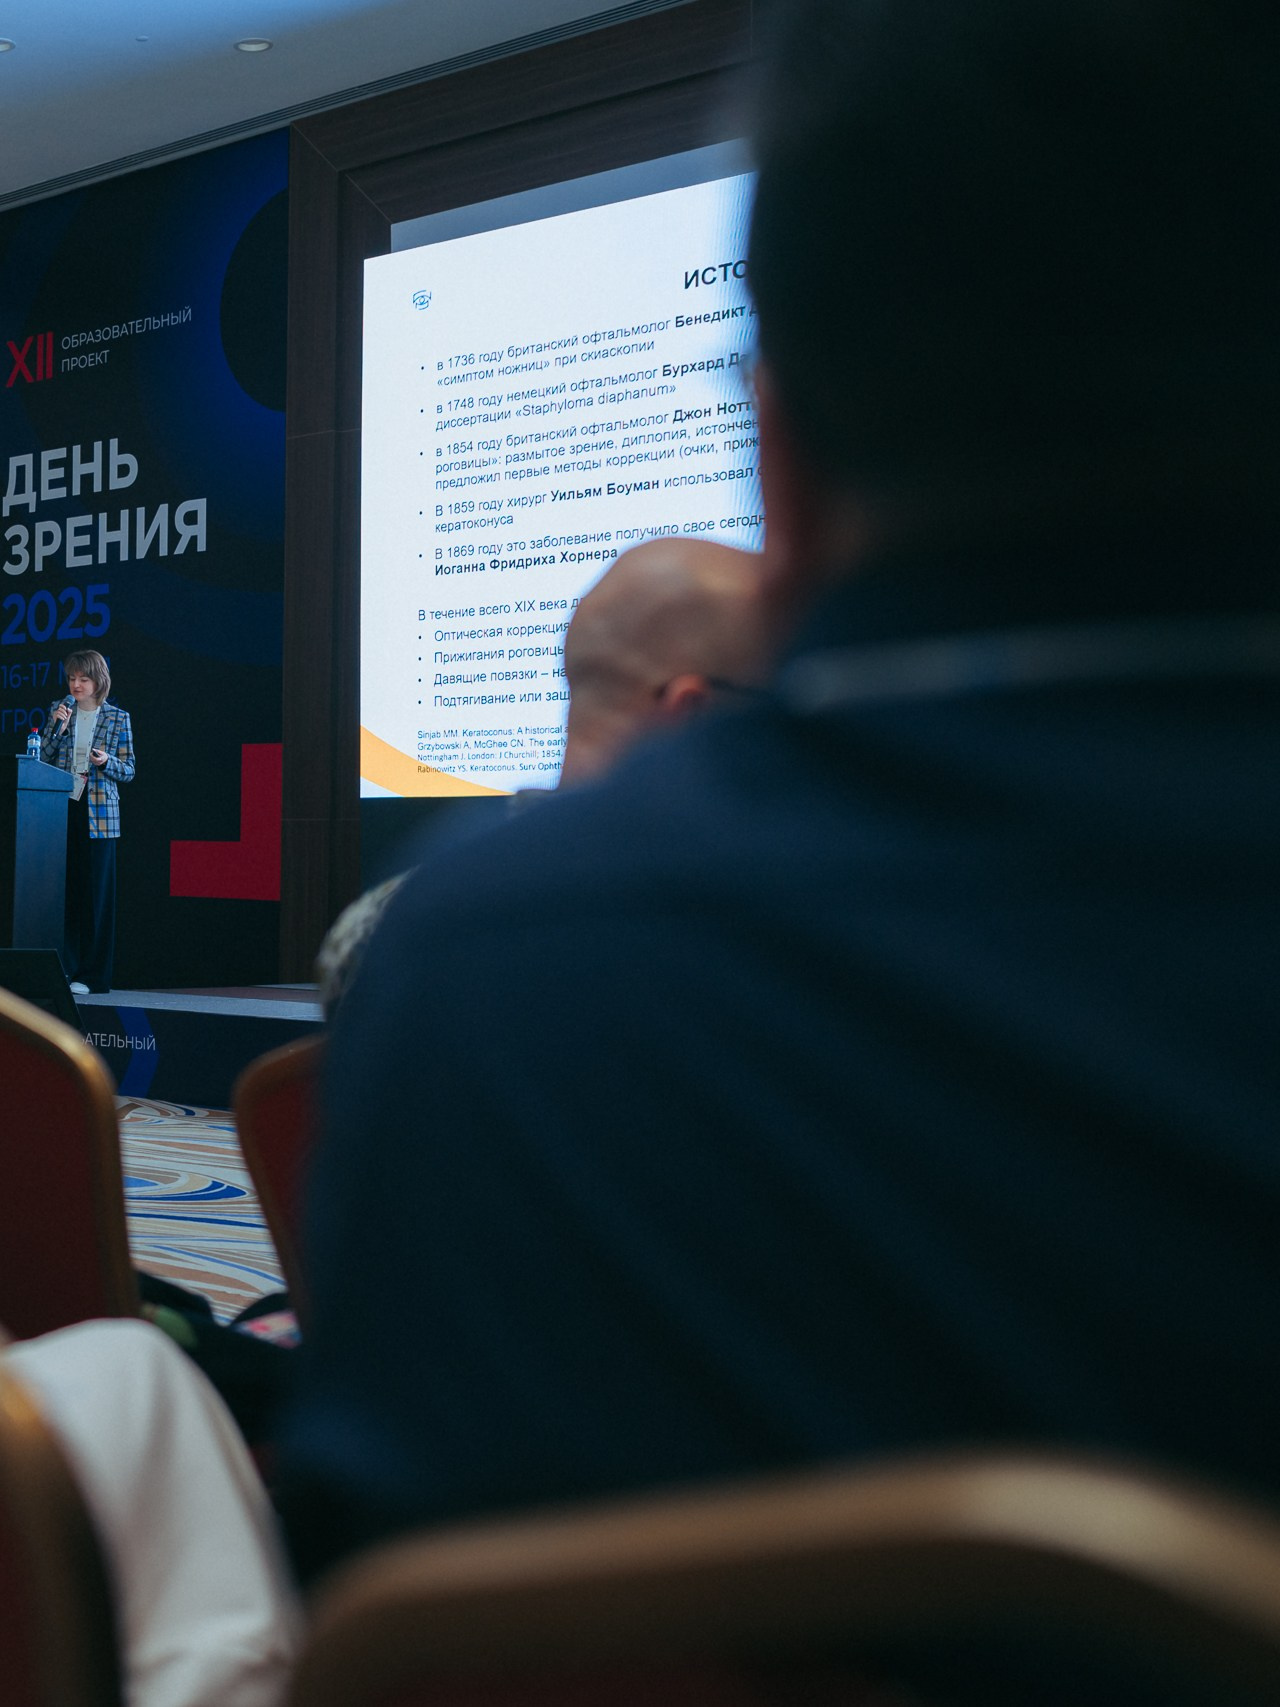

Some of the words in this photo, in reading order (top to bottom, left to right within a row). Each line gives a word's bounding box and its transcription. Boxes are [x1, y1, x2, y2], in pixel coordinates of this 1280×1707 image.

[684, 260, 749, 290] ИСТО
[61, 305, 192, 350] ОБРАЗОВАТЕЛЬНЫЙ
[437, 360, 444, 370] в
[448, 354, 476, 368] 1736
[479, 350, 504, 363] году
[508, 335, 578, 358] британский
[582, 320, 671, 345] офтальмолог
[675, 306, 746, 328] Бенедикт
[6, 331, 54, 388] XII
[61, 350, 110, 373] ПРОЕКТ
[437, 368, 494, 387] «симптом
[498, 361, 550, 377] ножниц»
[554, 353, 577, 368] при
[581, 340, 655, 362] скиаскопии
[436, 404, 443, 414] в
[448, 397, 474, 412] 1748
[478, 394, 504, 408] году
[506, 383, 566, 402] немецкий
[570, 368, 658, 392] офтальмолог
[662, 357, 724, 379] Бурхард
[436, 410, 511, 432] диссертации
[516, 396, 594, 417] «Staphyloma
[598, 384, 677, 405] diaphanum»
[436, 447, 442, 457] в
[447, 440, 474, 456] 1854
[478, 438, 502, 452] году
[506, 426, 577, 447] британский
[580, 413, 670, 436] офтальмолог
[672, 406, 712, 423] Джон
[436, 456, 502, 476] роговицы»:
[505, 446, 566, 466] размытое
[570, 438, 618, 456] зрение,
[622, 428, 691, 448] диплопия,
[2, 437, 139, 517] ДЕНЬ
[436, 472, 501, 492] предложил
[504, 464, 550, 482] первые
[554, 458, 602, 474] методы
[606, 448, 675, 468] коррекции
[679, 443, 718, 460] (очки,
[436, 505, 444, 517] В
[448, 500, 475, 515] 1859
[478, 498, 504, 512] году
[507, 492, 548, 508] хирург
[550, 486, 602, 502] Уильям
[606, 479, 660, 496] Боуман
[664, 467, 754, 488] использовал
[2, 497, 208, 576] ЗРЕНИЯ
[435, 514, 514, 534] кератоконуса
[435, 548, 443, 560] В
[448, 544, 474, 558] 1869
[478, 542, 504, 556] году
[506, 540, 526, 552] это
[530, 530, 612, 550] заболевание
[616, 523, 679, 541] получило
[683, 520, 716, 534] свое
[435, 561, 486, 576] Иоганна
[490, 553, 556, 571] Фридриха
[560, 548, 618, 565] Хорнера
[0, 583, 111, 645] 2025
[418, 609, 426, 621] В
[430, 608, 476, 620] течение
[479, 604, 511, 616] всего
[514, 600, 536, 613] XIX
[539, 599, 568, 611] века
[434, 626, 503, 642] Оптическая
[506, 622, 570, 638] коррекция
[434, 648, 505, 666] Прижигания
[1, 661, 51, 689] 16-17
[434, 672, 486, 688] Давящие
[490, 668, 538, 682] повязки
[434, 692, 516, 708] Подтягивание
[520, 690, 542, 703] или
[1, 706, 51, 733] ГРО
[417, 730, 441, 740] Sinjab
[517, 726, 524, 735] A
[525, 724, 562, 735] historical
[417, 742, 462, 752] Grzybowski
[474, 740, 508, 749] McGhee
[529, 738, 544, 747] The
[417, 753, 458, 762] Nottingham
[417, 764, 456, 773] Rabinowitz
[520, 762, 536, 771] Surv
[82, 1032, 156, 1051] АТЕЛЬНЫЙ
